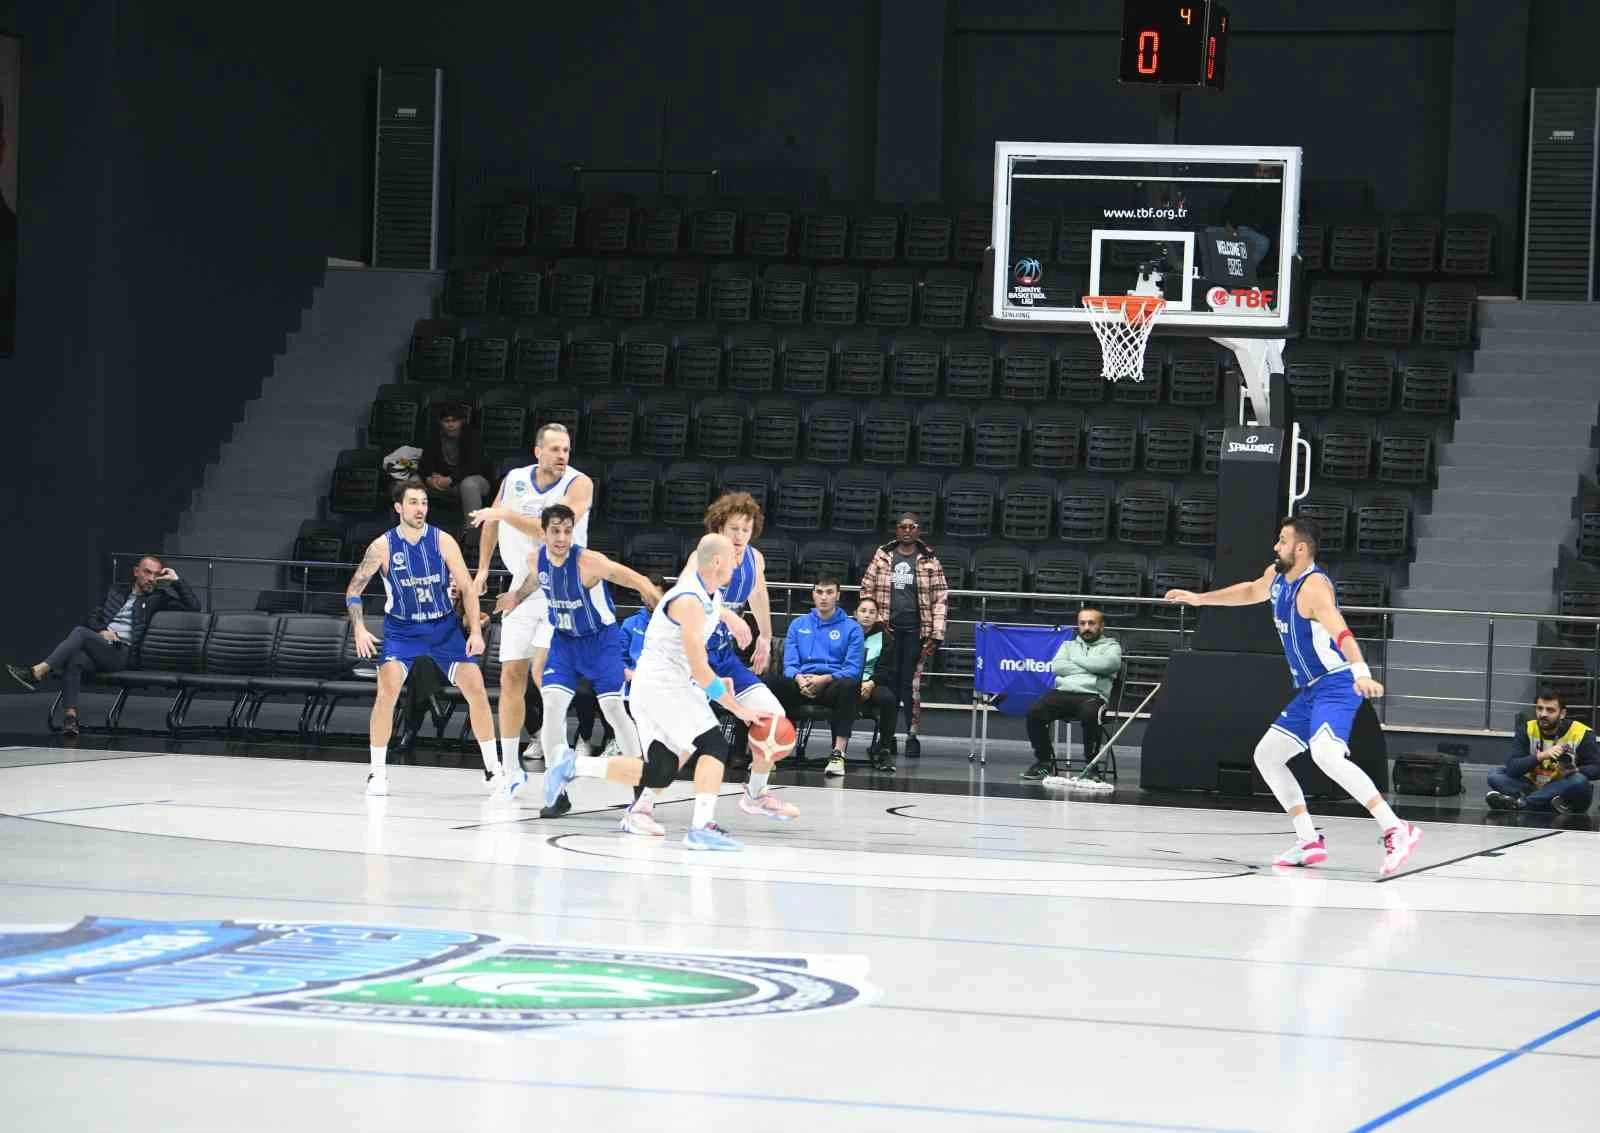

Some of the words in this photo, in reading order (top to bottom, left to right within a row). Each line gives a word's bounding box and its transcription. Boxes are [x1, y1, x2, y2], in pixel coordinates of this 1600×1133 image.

[1180, 8, 1191, 24] 4
[1138, 31, 1158, 73] 0
[1103, 207, 1187, 219] www.tbf.org.tr
[1231, 289, 1274, 310] TBF
[1227, 441, 1274, 455] SPALDING
[416, 587, 433, 603] 24
[1000, 658, 1054, 673] molten
